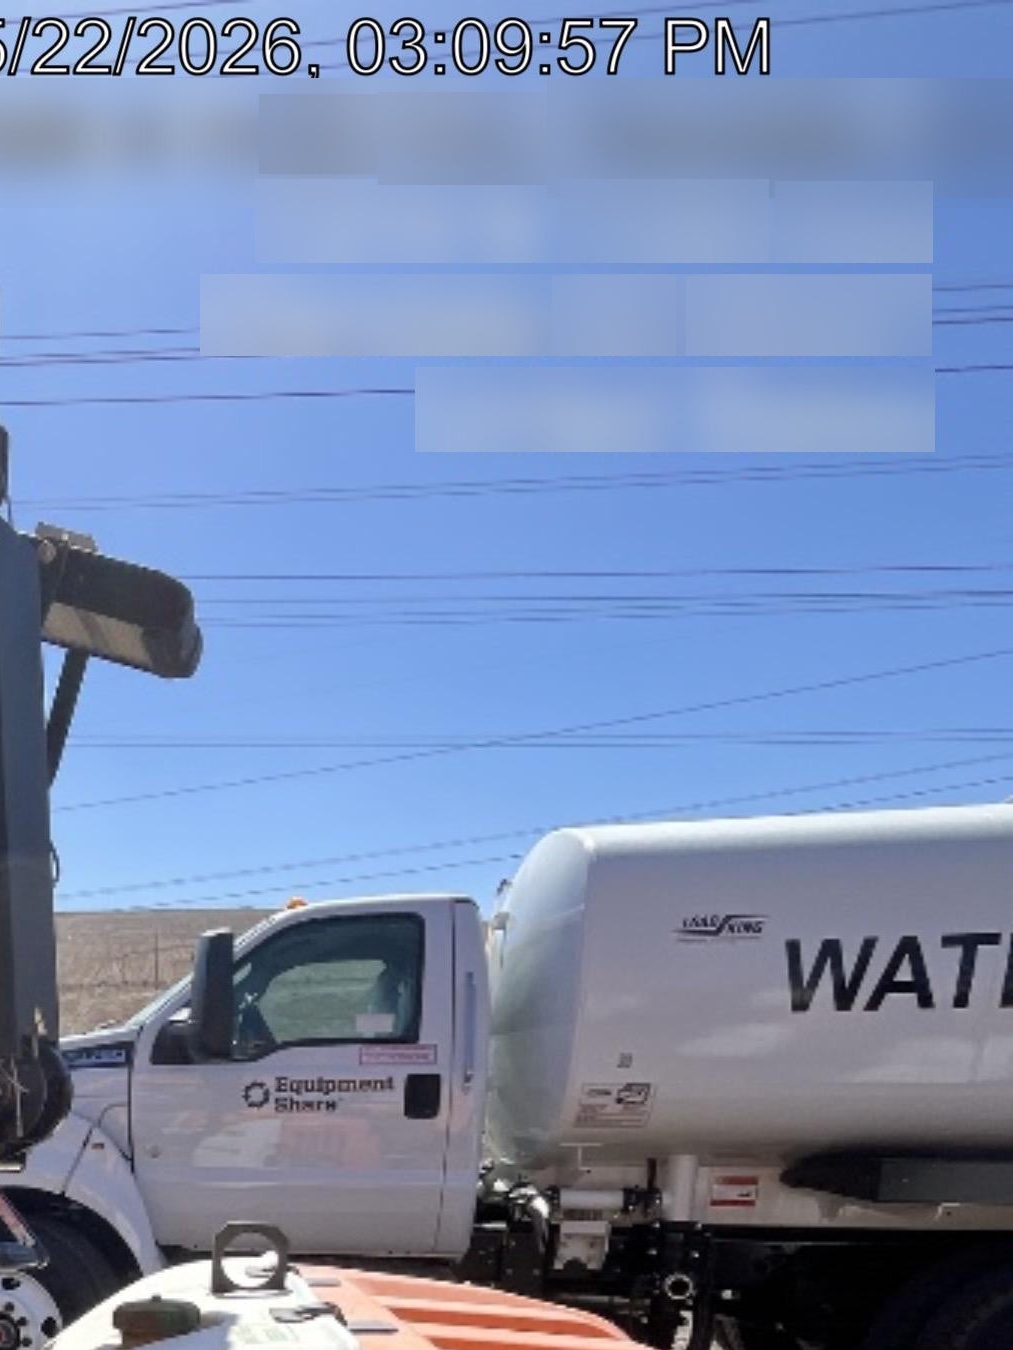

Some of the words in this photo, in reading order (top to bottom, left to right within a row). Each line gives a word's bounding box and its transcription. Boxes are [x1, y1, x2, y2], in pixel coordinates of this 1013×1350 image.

[785, 932, 1013, 1012] WAT
[275, 1076, 394, 1095] Equipment
[275, 1097, 337, 1112] Share
